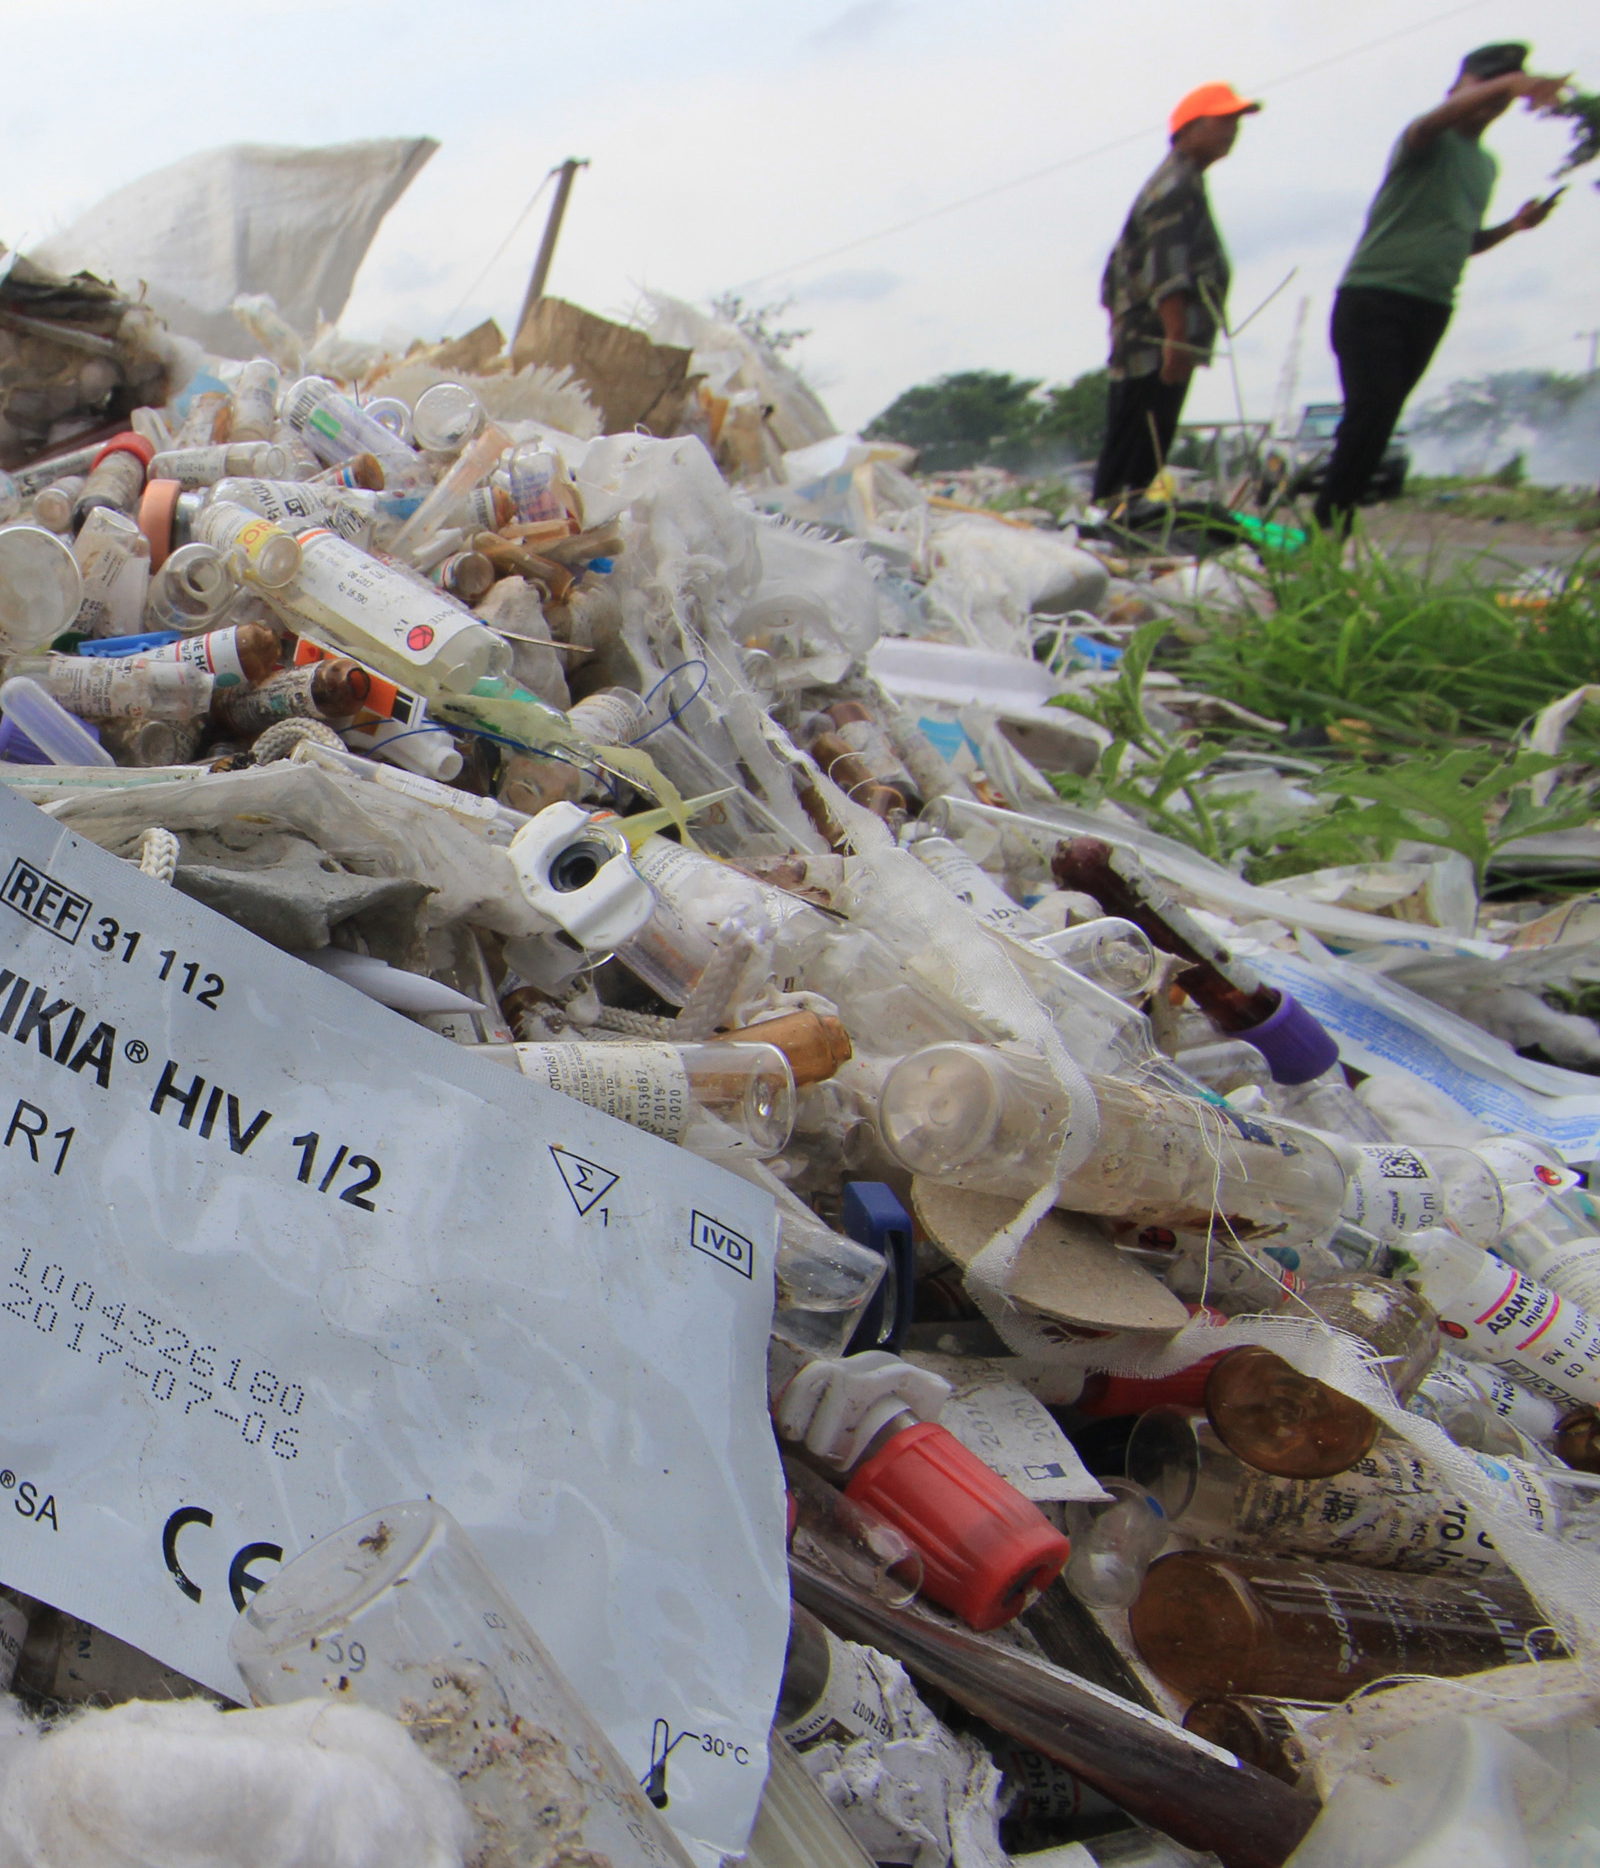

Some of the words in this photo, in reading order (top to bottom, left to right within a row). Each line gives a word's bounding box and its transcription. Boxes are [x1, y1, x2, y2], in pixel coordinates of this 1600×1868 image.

[6, 867, 86, 934] REF
[91, 917, 141, 963] 31
[158, 949, 225, 1011] 112
[2, 1098, 76, 1176] R1
[149, 1059, 273, 1155] HIV
[292, 1131, 383, 1213] 1/2
[702, 1225, 744, 1262] IVD
[12, 1247, 306, 1417] 1004326180
[1485, 1290, 1527, 1336] ASAM
[0, 1281, 300, 1460] 2017-07-06
[1563, 1361, 1586, 1380] ED
[701, 1733, 750, 1766] 30°C
